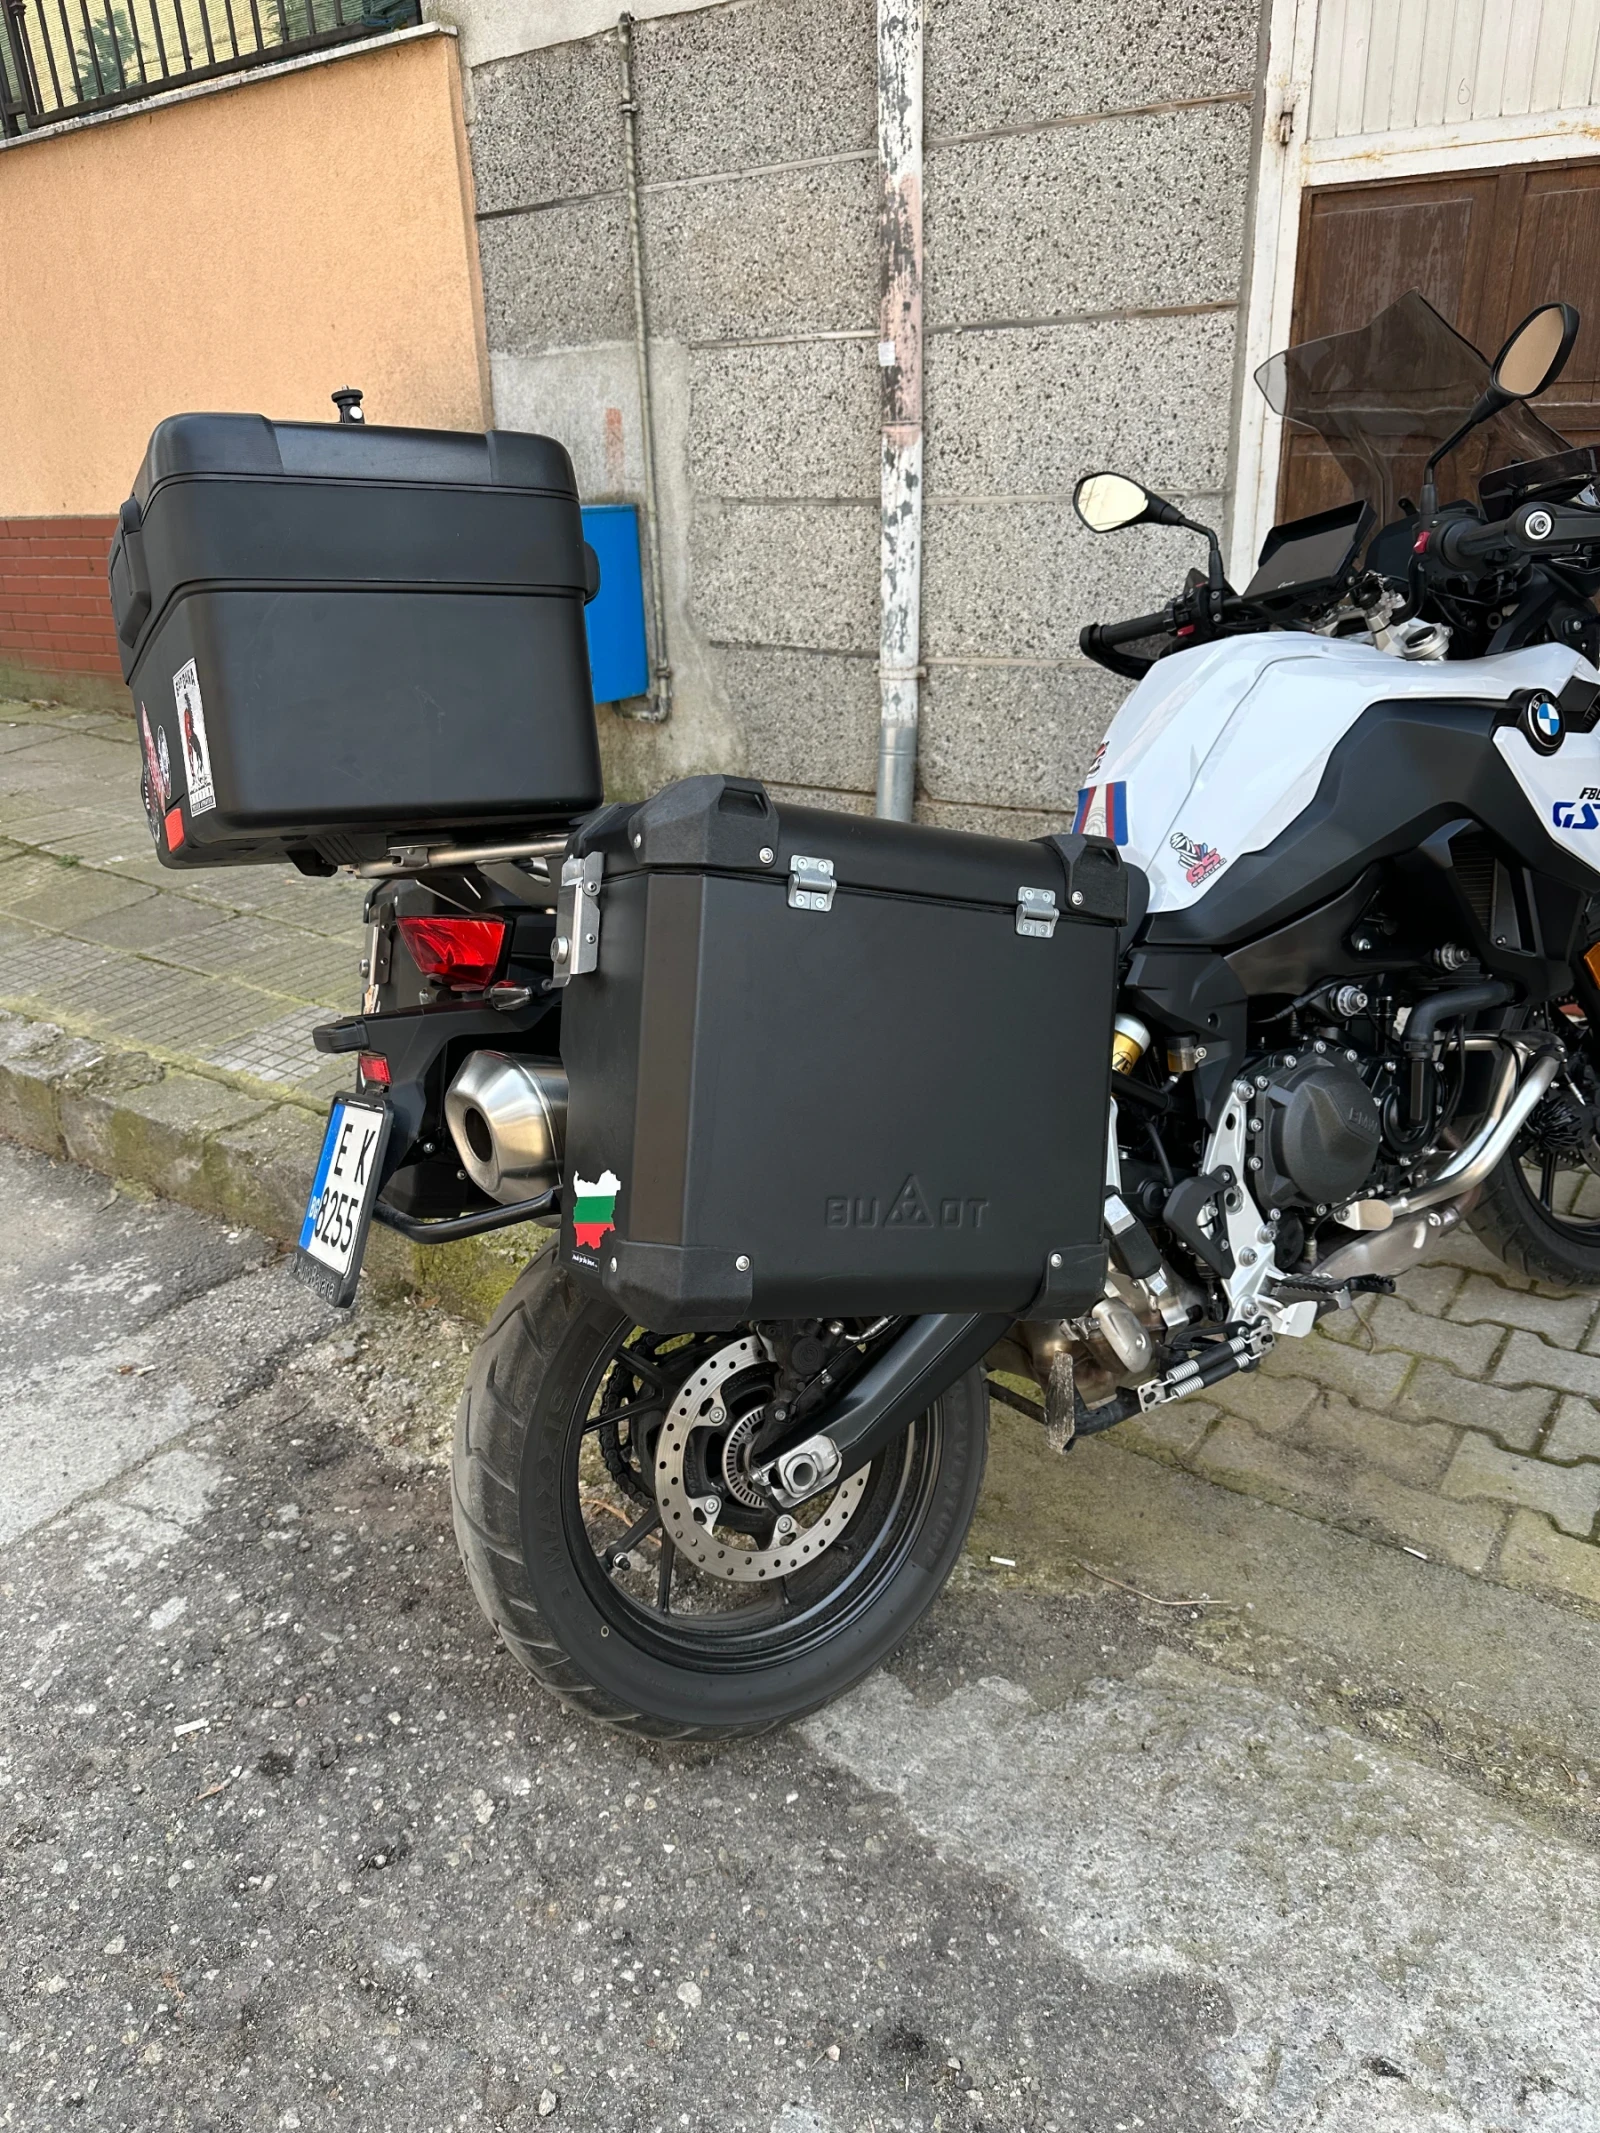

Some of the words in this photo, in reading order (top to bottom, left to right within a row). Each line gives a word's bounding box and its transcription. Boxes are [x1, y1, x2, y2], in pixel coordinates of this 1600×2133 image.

[1553, 801, 1600, 830] GS
[1186, 848, 1221, 884] GS
[308, 1196, 320, 1219] BG
[314, 1186, 360, 1254] 8255
[535, 1385, 571, 1578] MAXXIS
